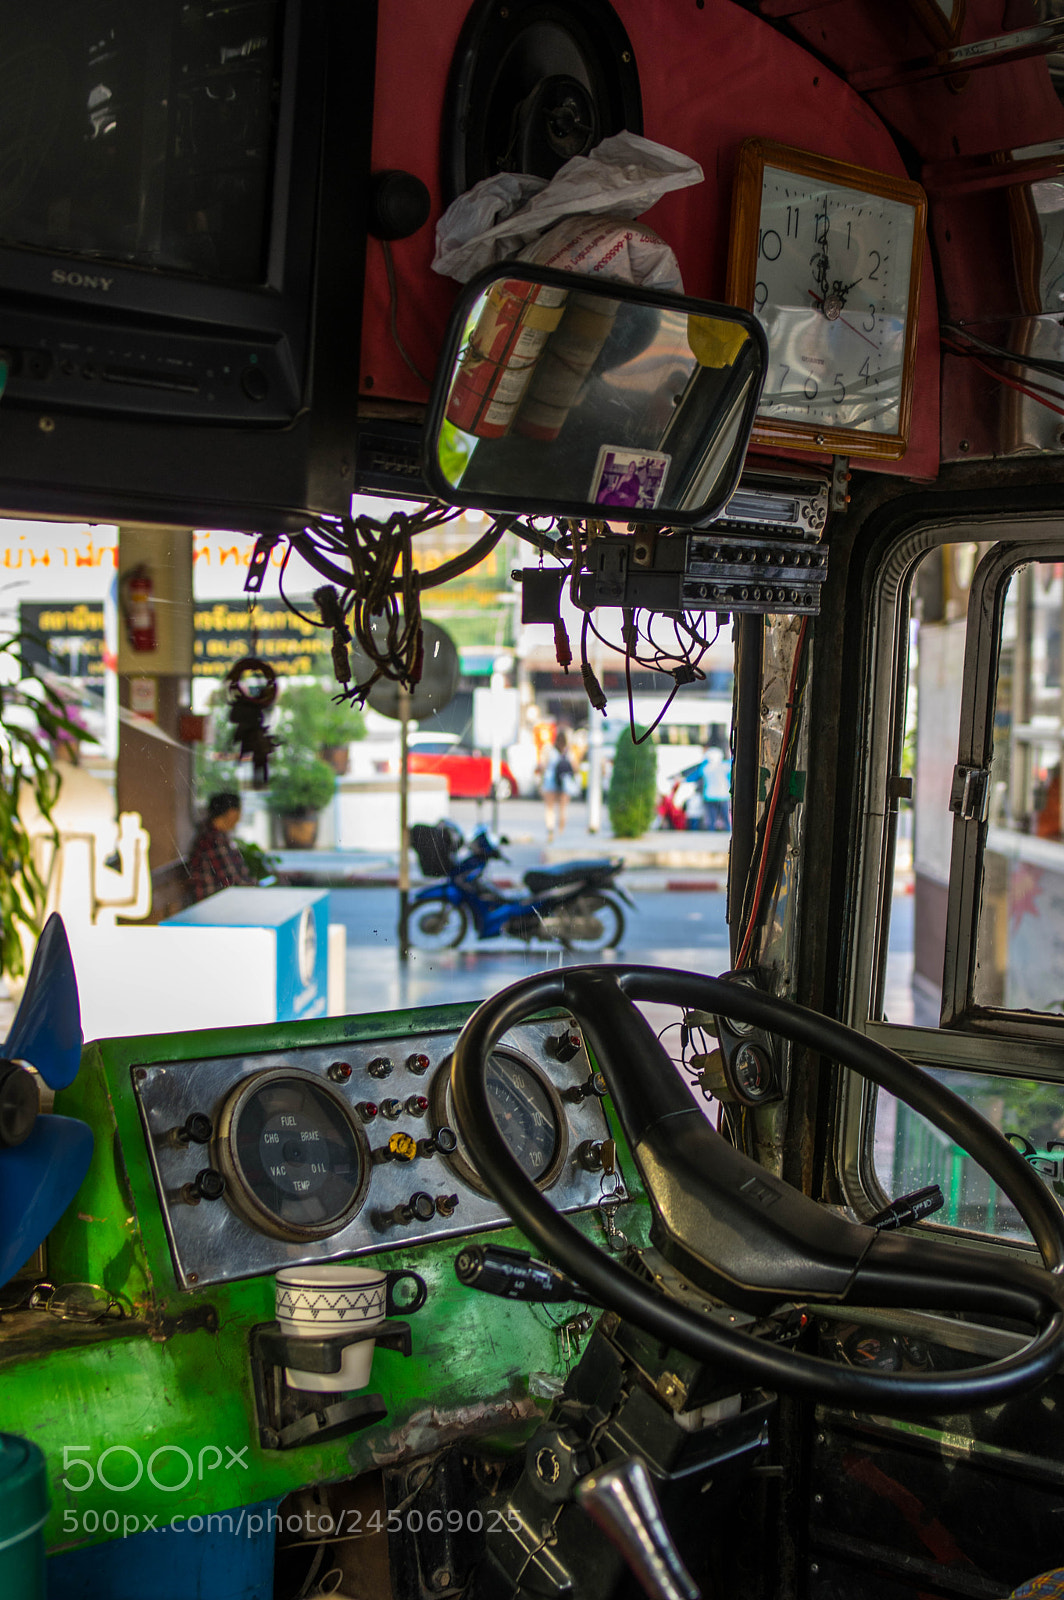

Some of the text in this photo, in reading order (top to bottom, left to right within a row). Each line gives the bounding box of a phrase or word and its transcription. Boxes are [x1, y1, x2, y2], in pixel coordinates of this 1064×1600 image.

[786, 205, 800, 239] 11
[846, 220, 852, 250] 1
[757, 228, 782, 261] 10
[51, 268, 114, 292] SONY
[868, 250, 881, 281] 2
[754, 281, 769, 313] 9
[862, 303, 876, 333] 3
[779, 363, 791, 392] 7
[804, 370, 818, 400] 6
[858, 356, 871, 385] 4
[832, 373, 846, 405] 5
[280, 1116, 297, 1127] FUEL
[300, 1130, 320, 1142] BRAKE
[270, 1165, 287, 1177] VAC
[311, 1162, 327, 1174] OIL
[528, 1151, 544, 1168] 120
[292, 1180, 311, 1192] TEMP
